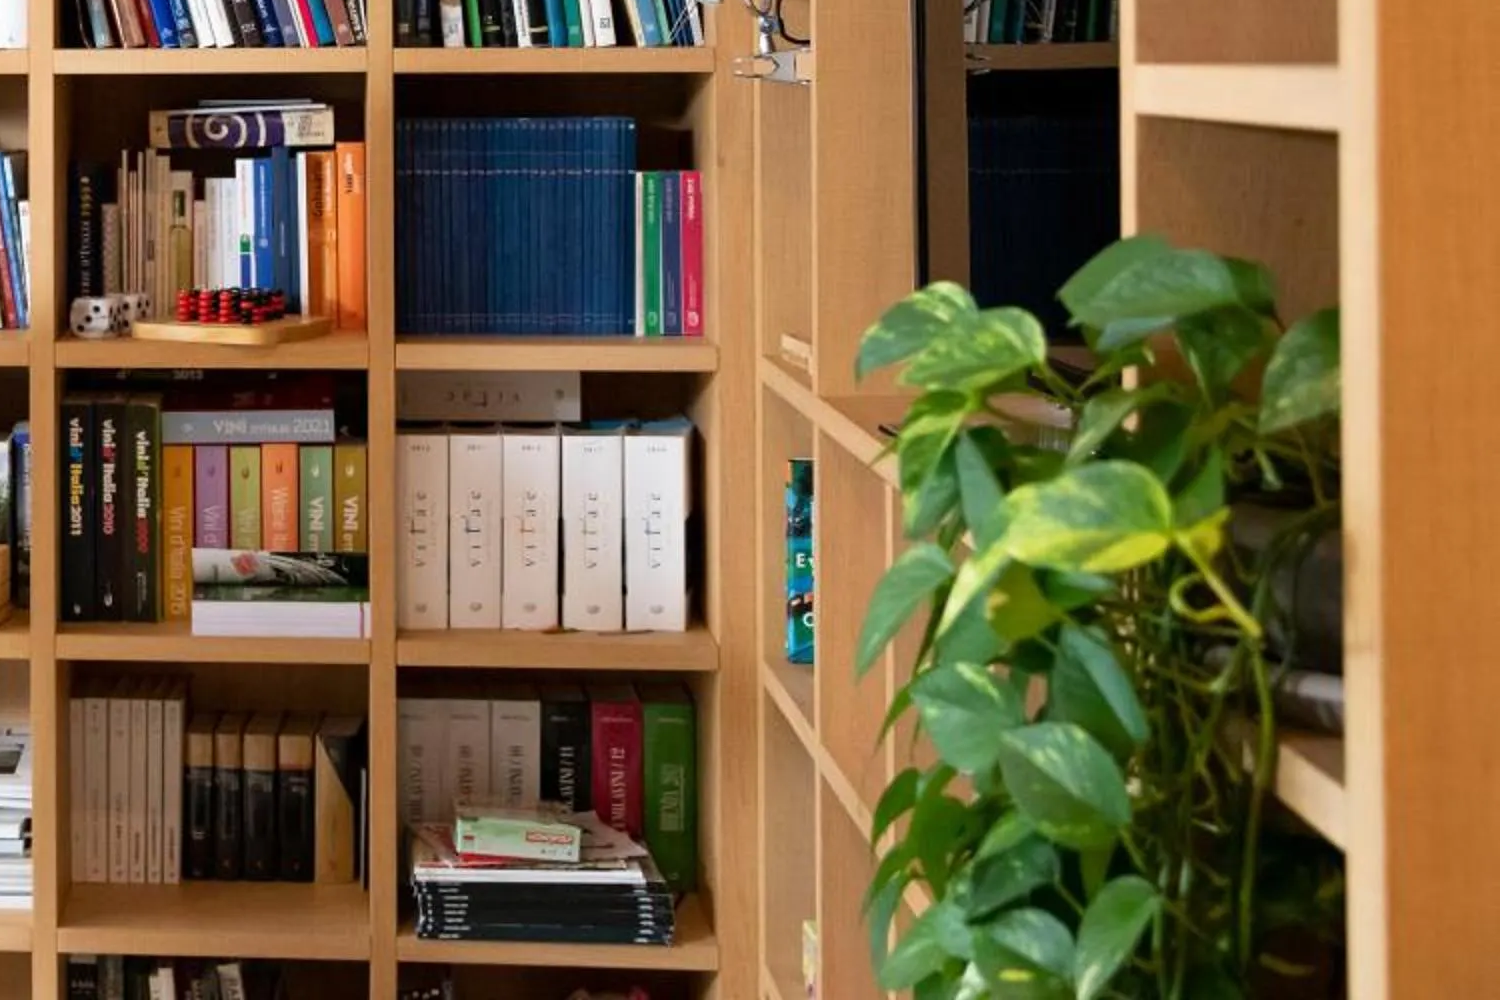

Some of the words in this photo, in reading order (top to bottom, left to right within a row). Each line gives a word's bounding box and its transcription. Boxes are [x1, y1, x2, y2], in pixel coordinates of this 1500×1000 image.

[69, 418, 83, 447] vini
[213, 419, 247, 436] VINI
[293, 418, 330, 434] 2021
[136, 431, 150, 460] vini
[69, 506, 83, 536] 2011
[309, 496, 324, 531] VINI
[343, 496, 358, 531] VINI
